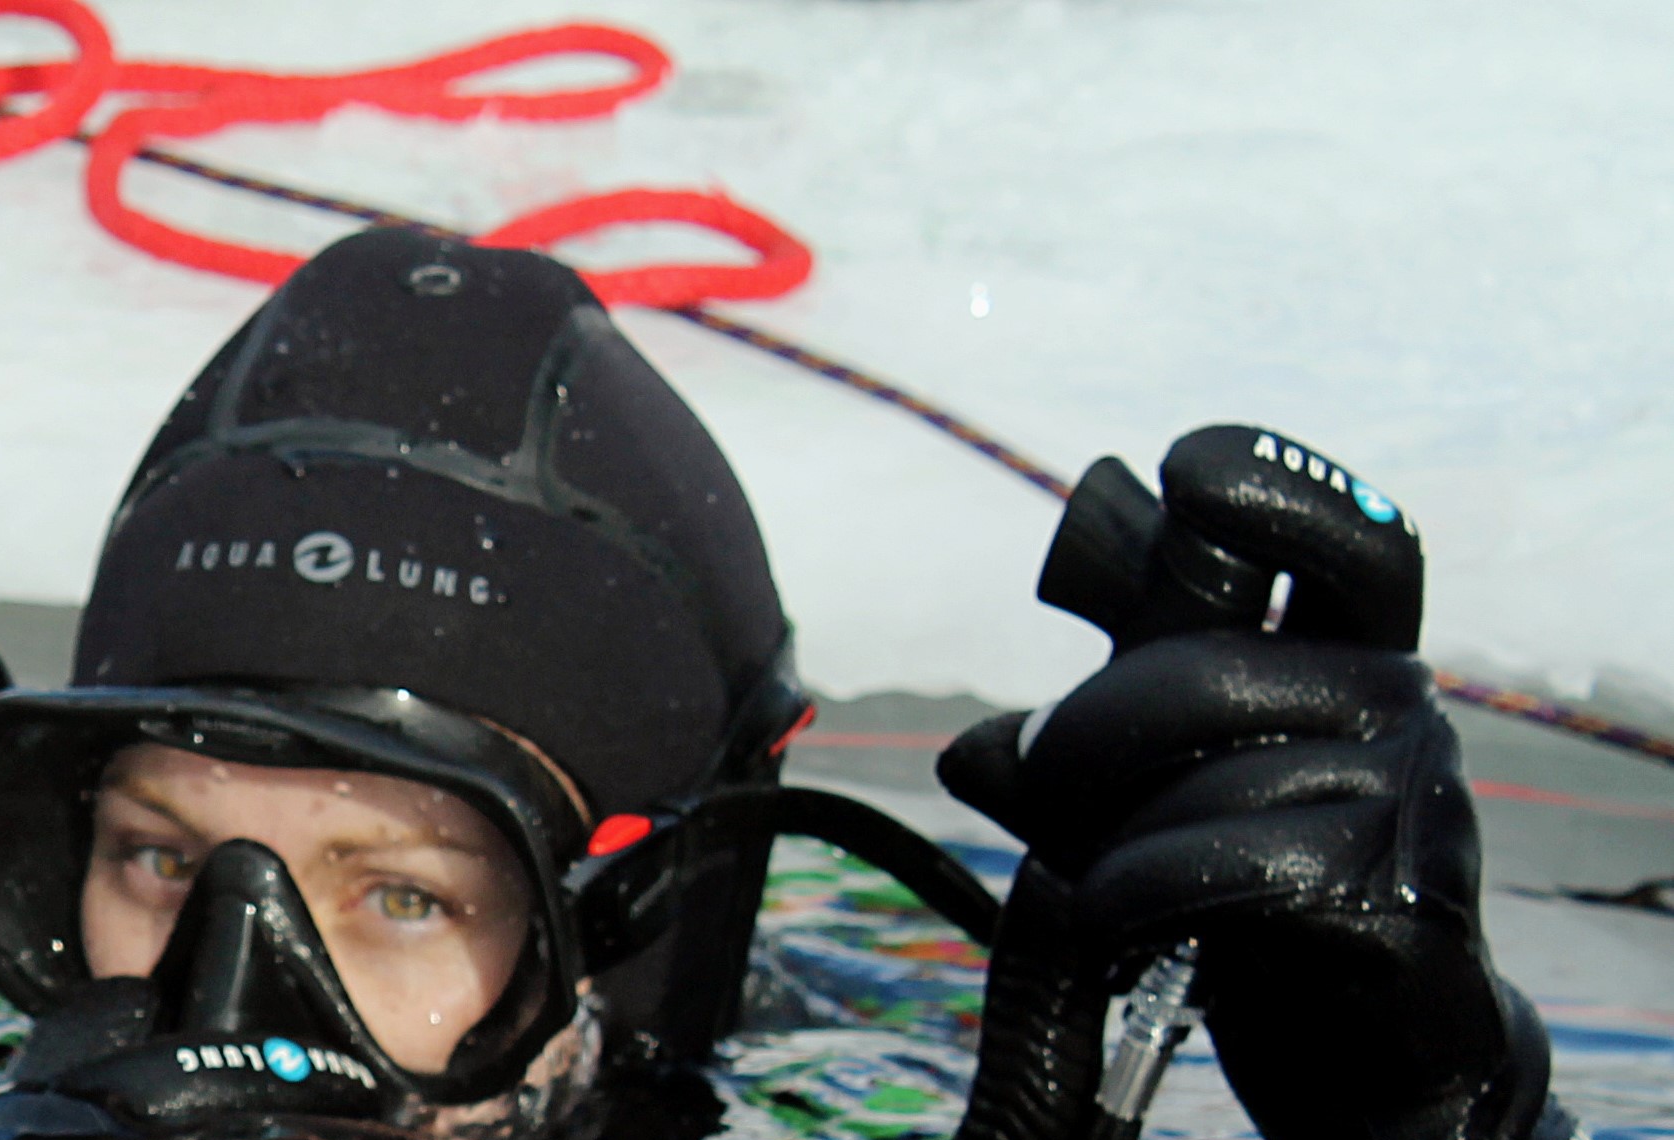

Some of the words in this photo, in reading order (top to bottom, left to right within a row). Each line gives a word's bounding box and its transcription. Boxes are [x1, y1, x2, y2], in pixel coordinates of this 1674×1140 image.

[1253, 433, 1348, 494] AQUA
[176, 541, 276, 571] AQUA
[366, 549, 490, 605] LUNG
